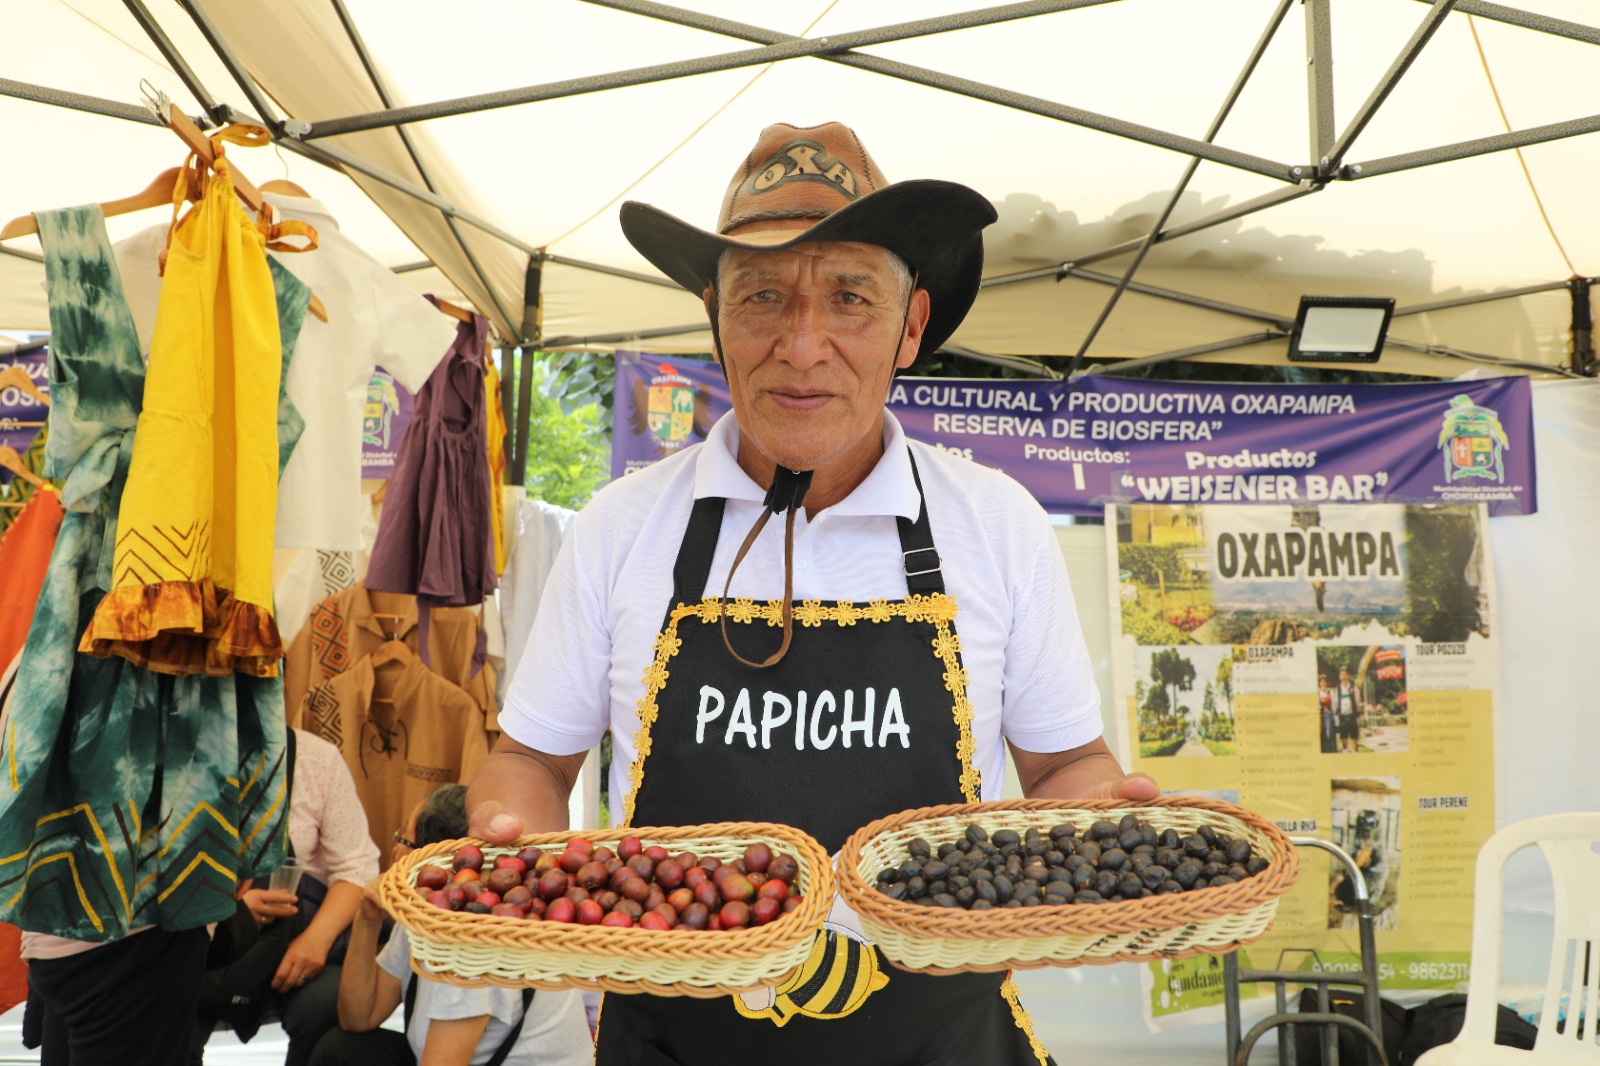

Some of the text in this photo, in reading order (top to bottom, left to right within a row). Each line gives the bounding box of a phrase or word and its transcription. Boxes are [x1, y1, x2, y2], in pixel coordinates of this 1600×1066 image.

[753, 145, 857, 196] OXA
[913, 385, 1044, 412] CULTURAL
[1050, 393, 1065, 411] Y
[1068, 391, 1226, 414] PRODUCTIVA
[1231, 393, 1356, 415] OXAPAMPA
[933, 413, 1046, 438] RESERVA
[1052, 418, 1086, 439] DE
[1024, 444, 1131, 464] Productos:
[1185, 448, 1318, 470] Productos
[1120, 471, 1389, 502] “WEISENER BAR”
[1216, 531, 1399, 579] OXAPAMPA
[1248, 646, 1295, 659] OXAPAMPA
[1416, 645, 1434, 656] TOUR
[695, 684, 911, 751] PAPICHA
[1418, 797, 1437, 809] TOUR
